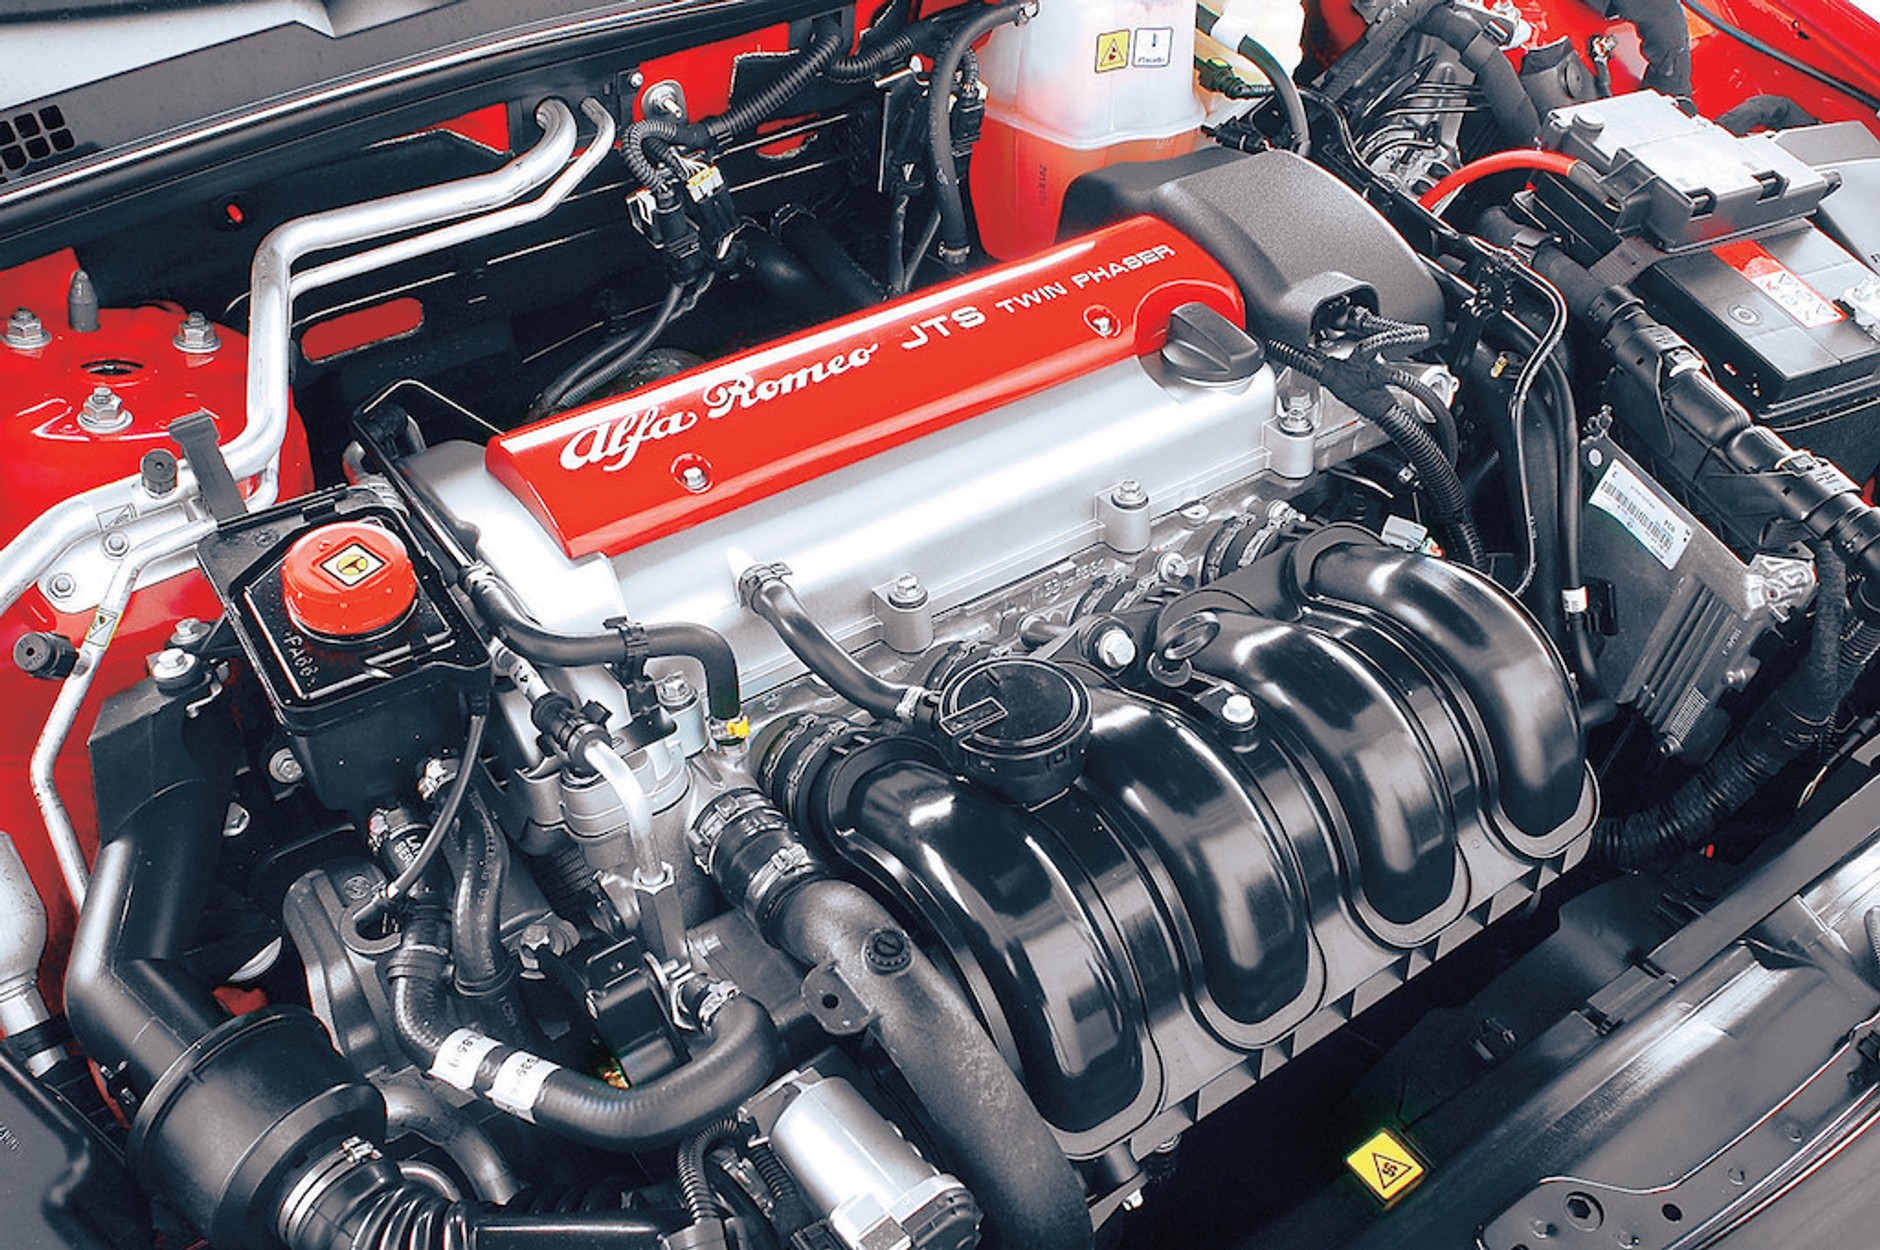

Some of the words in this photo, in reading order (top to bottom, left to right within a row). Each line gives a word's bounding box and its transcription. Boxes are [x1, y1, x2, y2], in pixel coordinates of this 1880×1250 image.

[559, 407, 698, 472] Alfa
[703, 343, 879, 418] Romeo
[901, 306, 986, 350] JTS
[995, 281, 1068, 314] TWIN
[1071, 244, 1176, 289] PHASER
